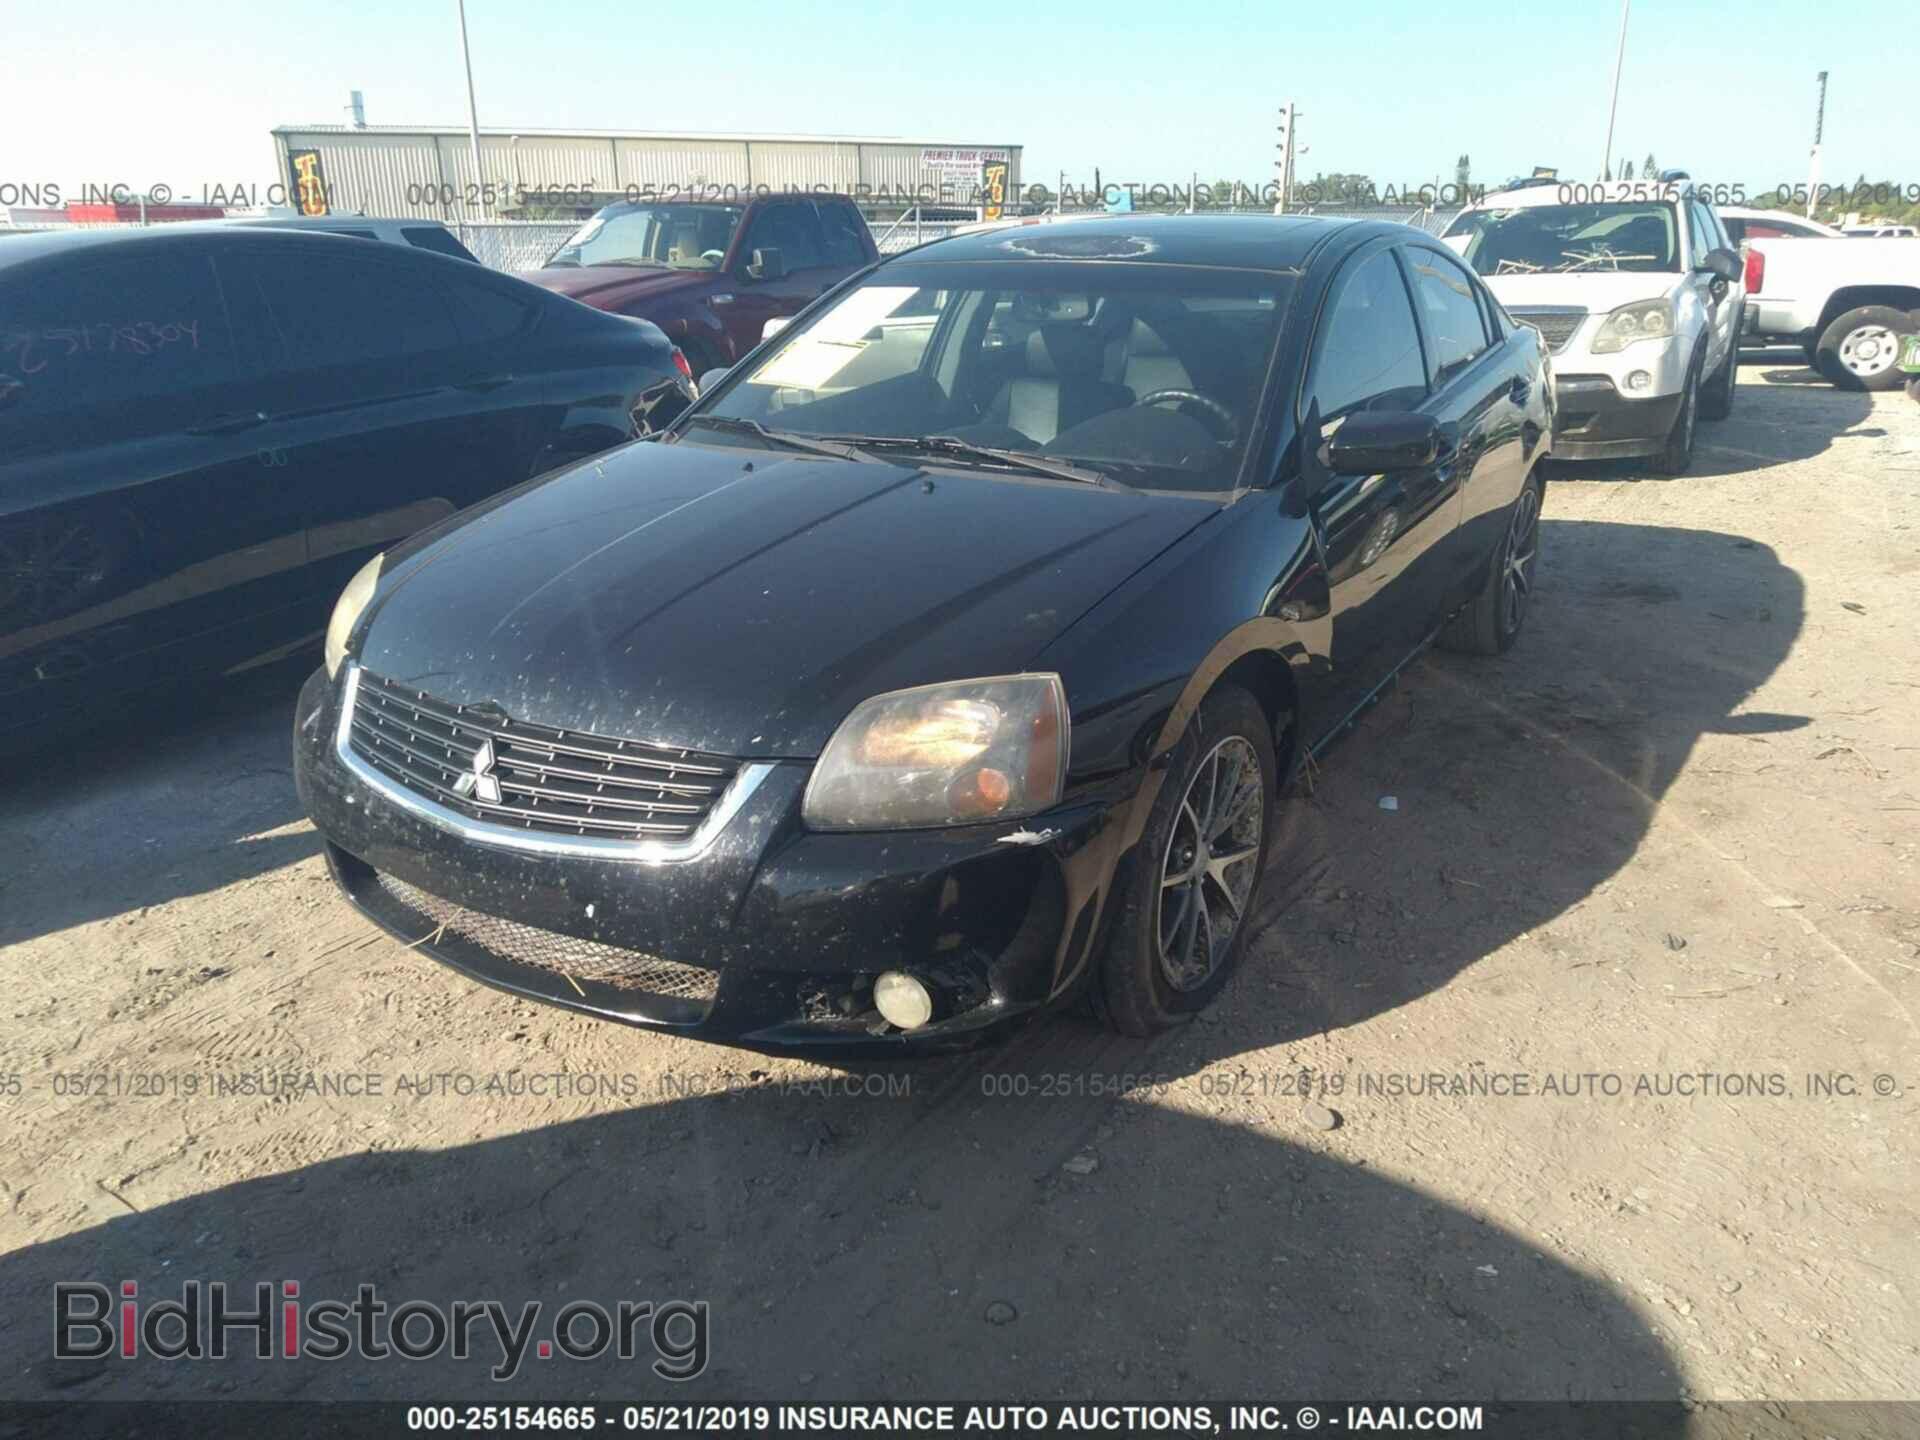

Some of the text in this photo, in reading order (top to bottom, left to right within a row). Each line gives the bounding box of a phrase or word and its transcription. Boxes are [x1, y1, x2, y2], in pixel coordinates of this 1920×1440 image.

[923, 150, 1006, 160] PREMIER TRUCK CENTER
